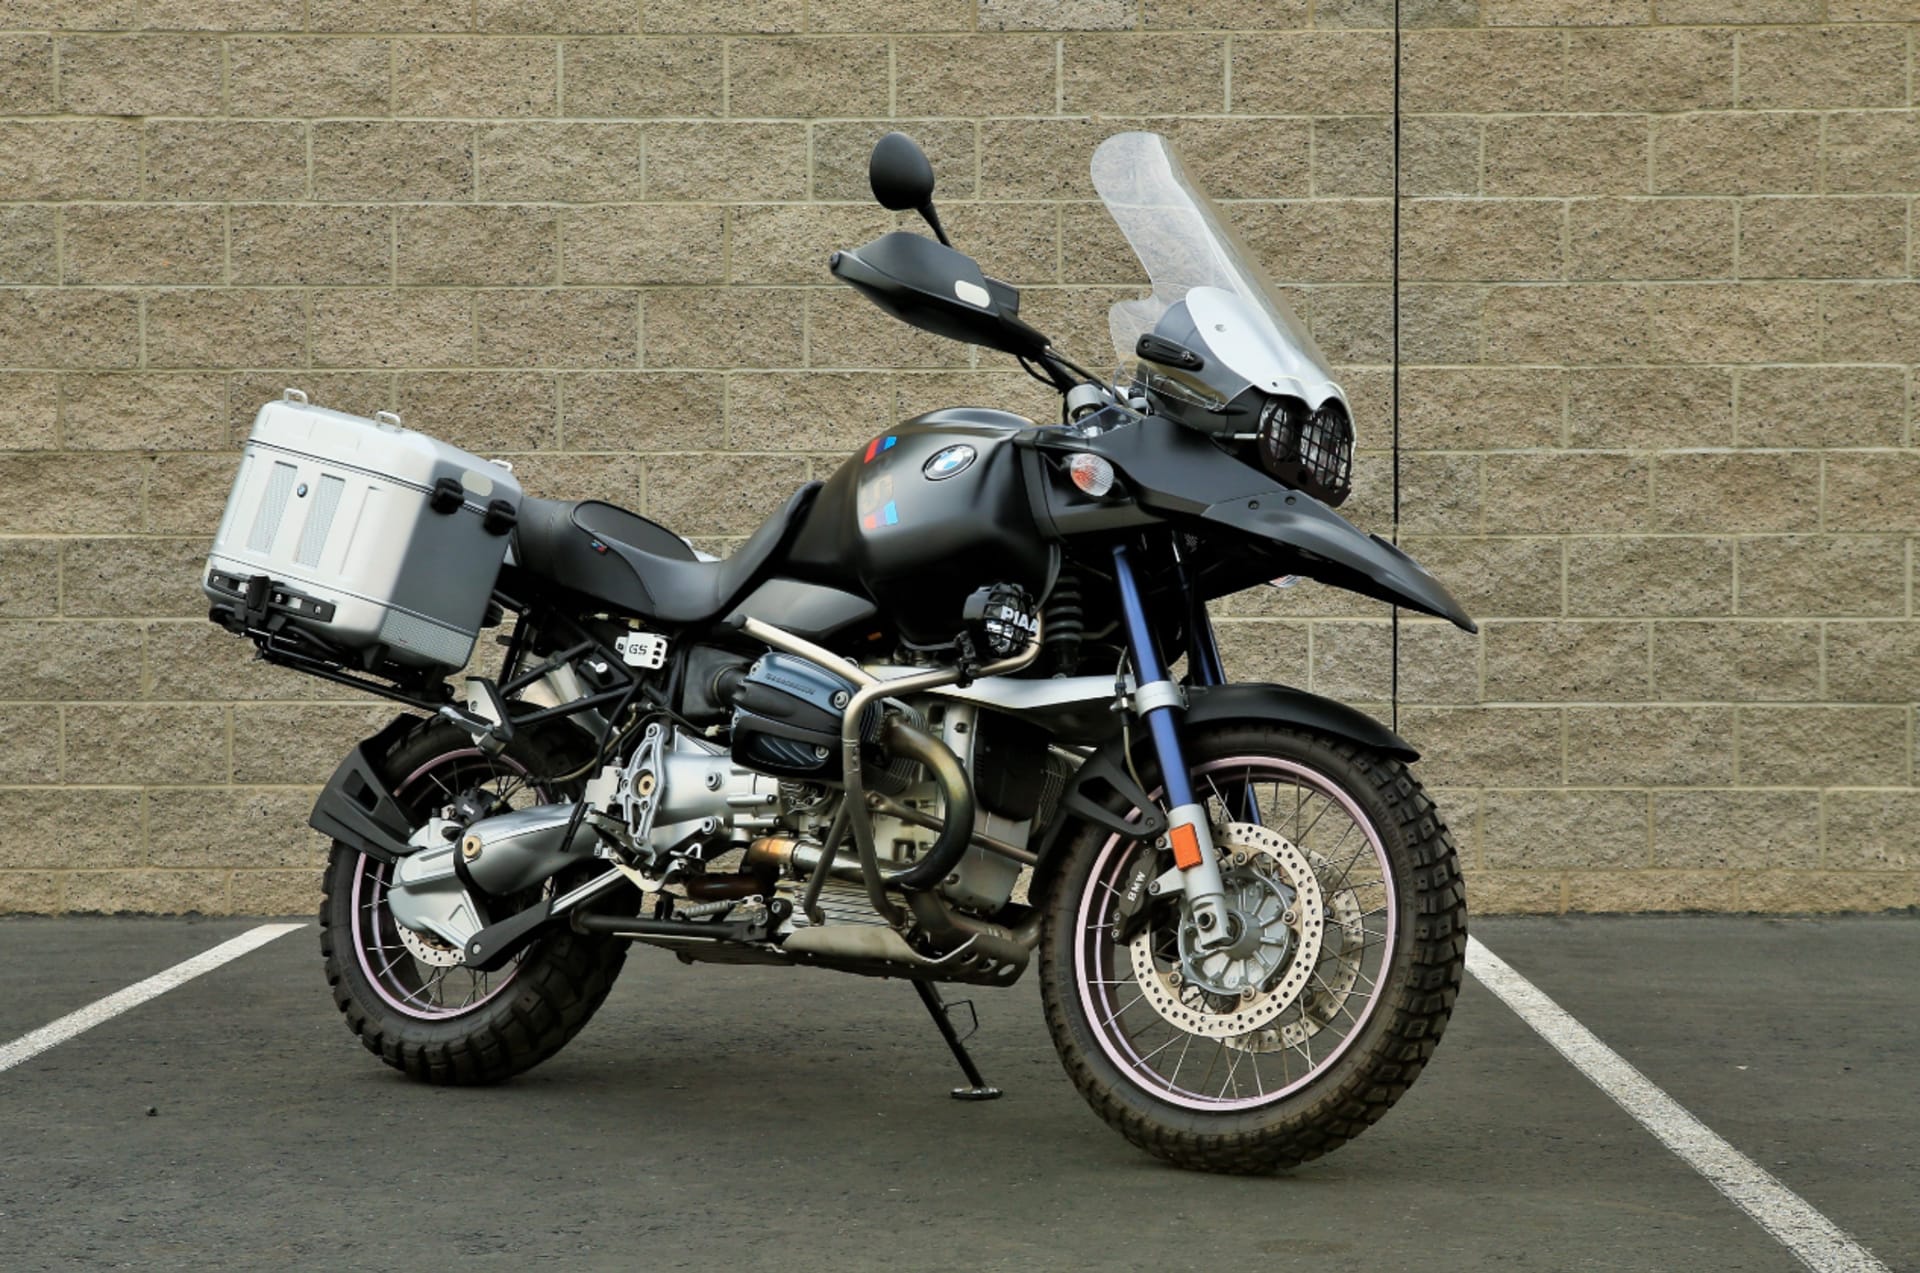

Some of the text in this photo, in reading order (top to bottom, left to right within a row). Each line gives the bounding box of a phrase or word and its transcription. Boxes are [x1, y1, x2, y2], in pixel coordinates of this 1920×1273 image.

[1000, 605, 1039, 634] PIAA
[628, 643, 649, 656] GS
[1127, 871, 1146, 902] BMW
